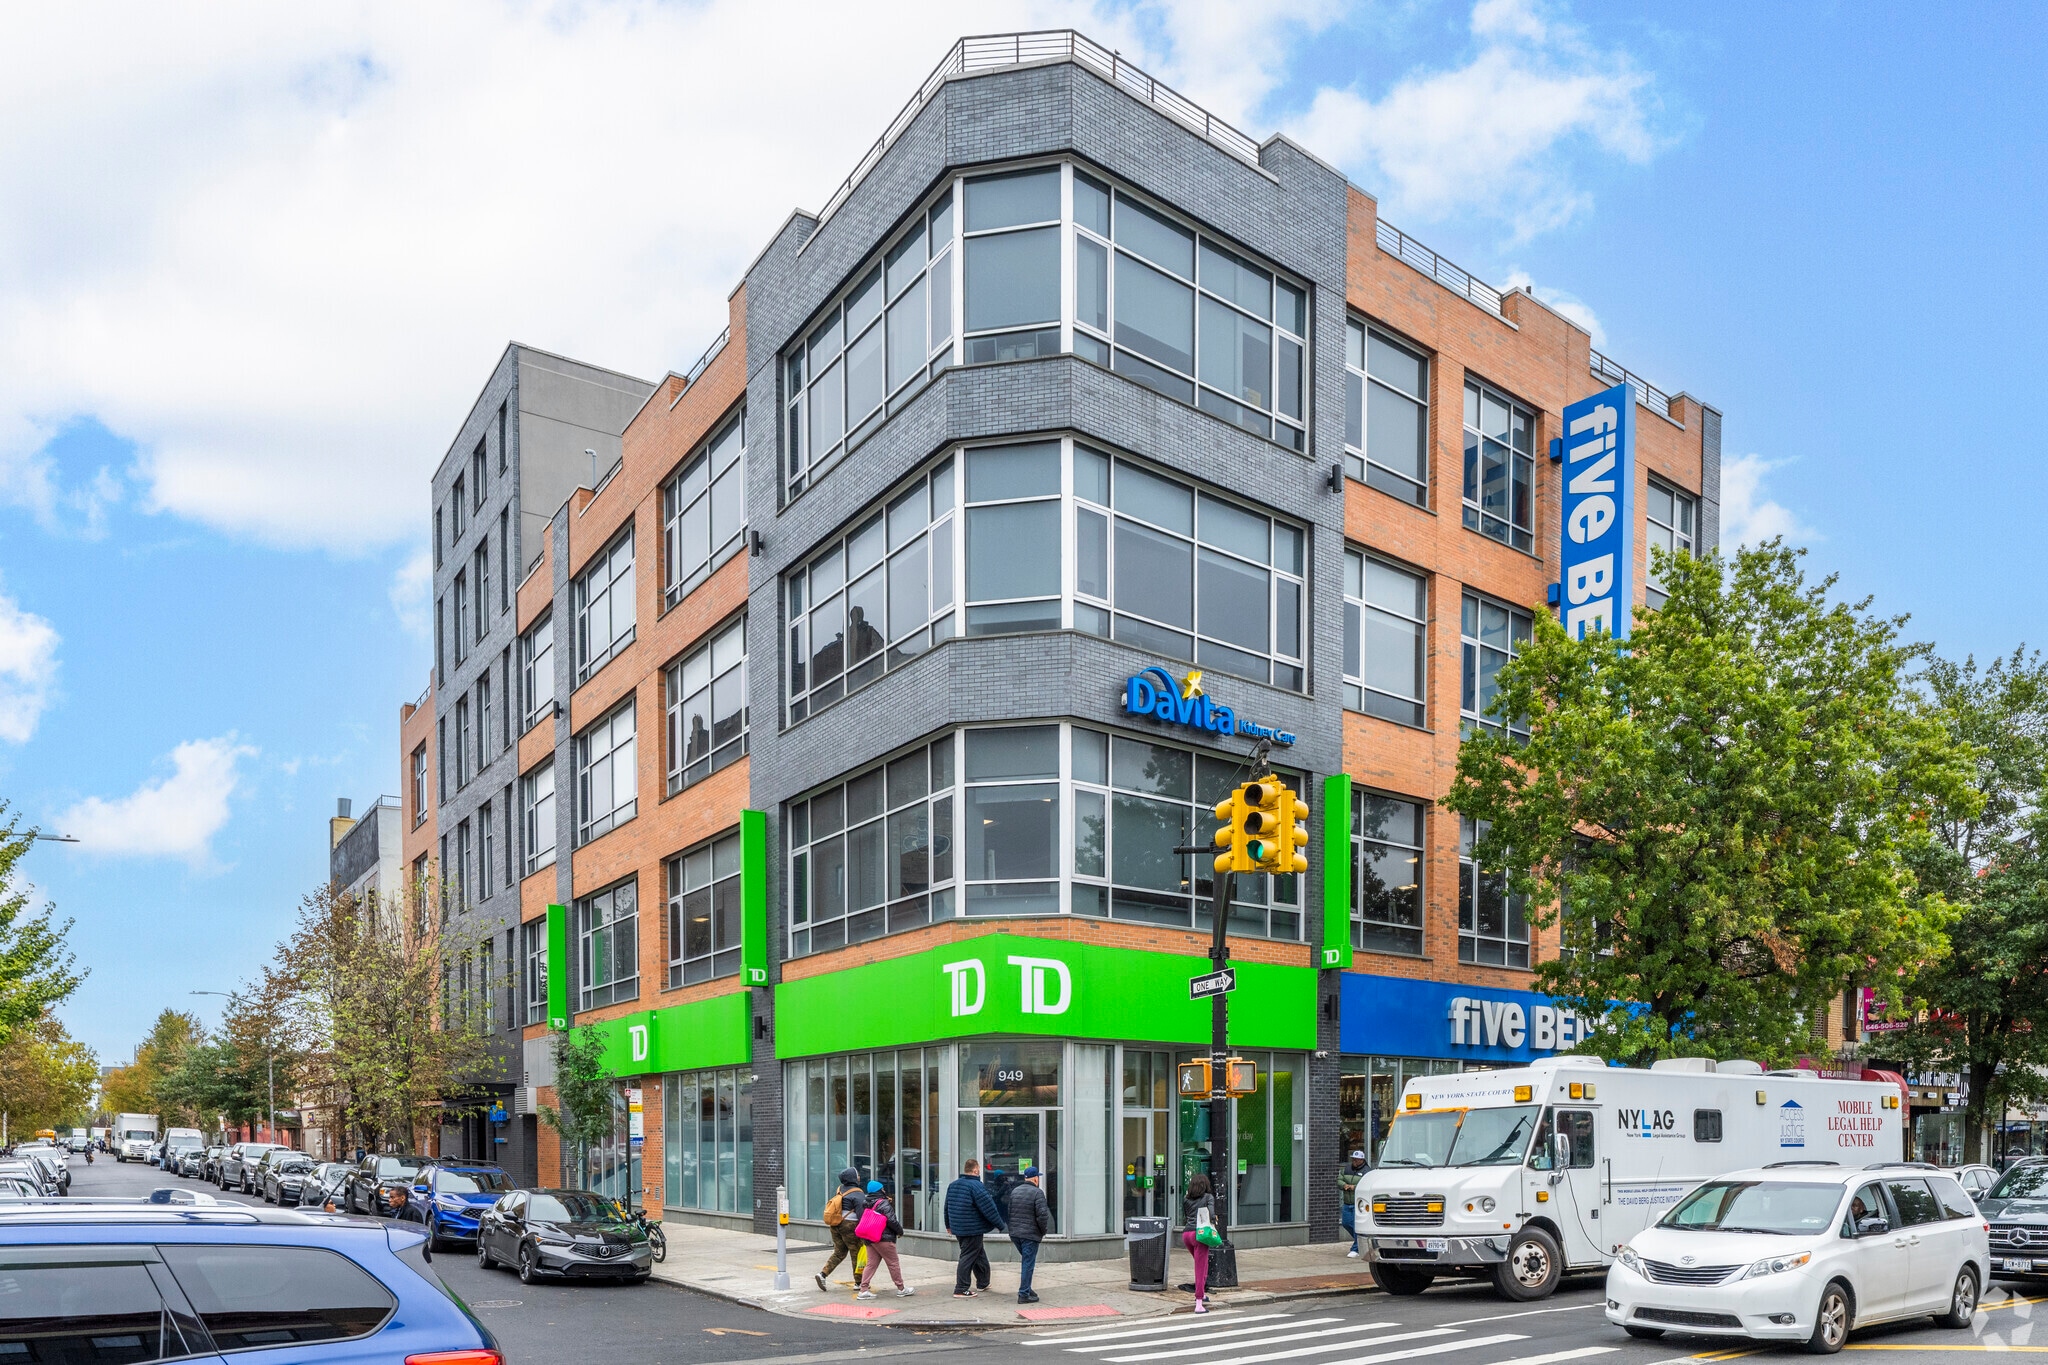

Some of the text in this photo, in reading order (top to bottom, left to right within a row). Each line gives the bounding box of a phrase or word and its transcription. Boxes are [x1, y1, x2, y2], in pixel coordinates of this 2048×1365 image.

[1567, 403, 1618, 545] five
[1127, 667, 1296, 745] DaVita Kidney Care
[1323, 949, 1340, 965] TD
[749, 968, 766, 982] TD
[943, 958, 986, 1017] TD
[1007, 955, 1072, 1015] TD
[1196, 976, 1228, 992] ONE WAY
[551, 1017, 566, 1029] TD
[1448, 997, 1526, 1049] five
[629, 1024, 648, 1062] TD
[998, 1070, 1024, 1082] 949
[1780, 1108, 1805, 1121] ACCESS
[1837, 1100, 1873, 1115] MOBILE
[1618, 1109, 1675, 1130] NYLAG
[1828, 1117, 1883, 1131] LEGAL HELP
[1780, 1124, 1805, 1138] JUSTICE
[1837, 1133, 1875, 1147] CENTER
